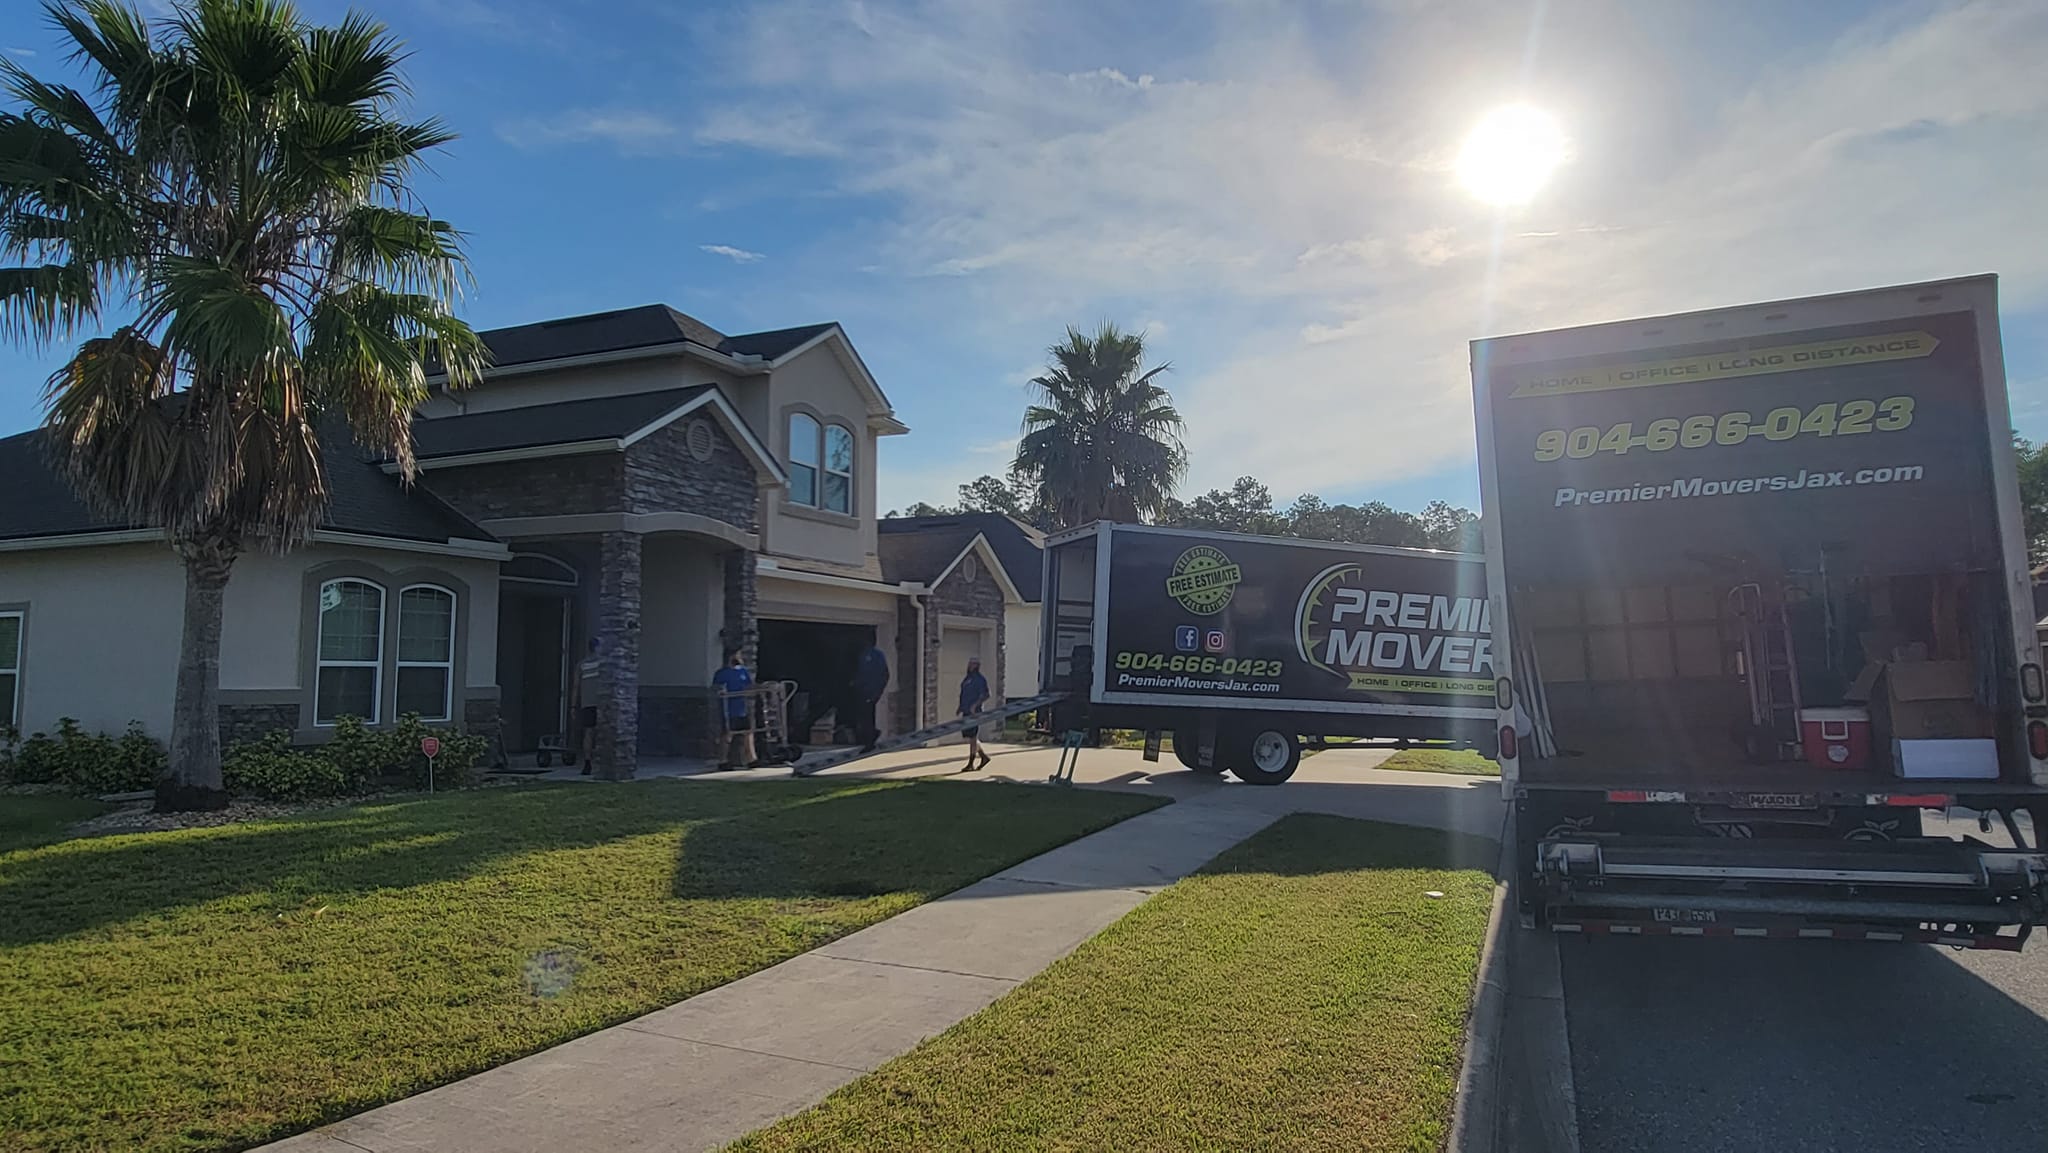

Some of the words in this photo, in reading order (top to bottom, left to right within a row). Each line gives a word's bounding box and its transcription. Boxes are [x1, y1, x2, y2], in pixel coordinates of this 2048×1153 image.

[1529, 375, 1593, 389] HOME
[1619, 364, 1699, 381] OFFICE
[1719, 354, 1785, 371] LONG
[1793, 339, 1921, 363] DISTANCE
[1533, 395, 1916, 463] 904-666-0423
[1554, 463, 1924, 508] PremierMoversJax.com
[1169, 577, 1193, 594] FREE
[1194, 567, 1239, 588] ESTIMATE
[1115, 652, 1283, 677] 904-666-0423
[1118, 673, 1280, 692] PremierMoversJax.com
[1357, 677, 1389, 686] HOME
[1400, 680, 1438, 689] OFFICE
[1445, 683, 1474, 691] LONG
